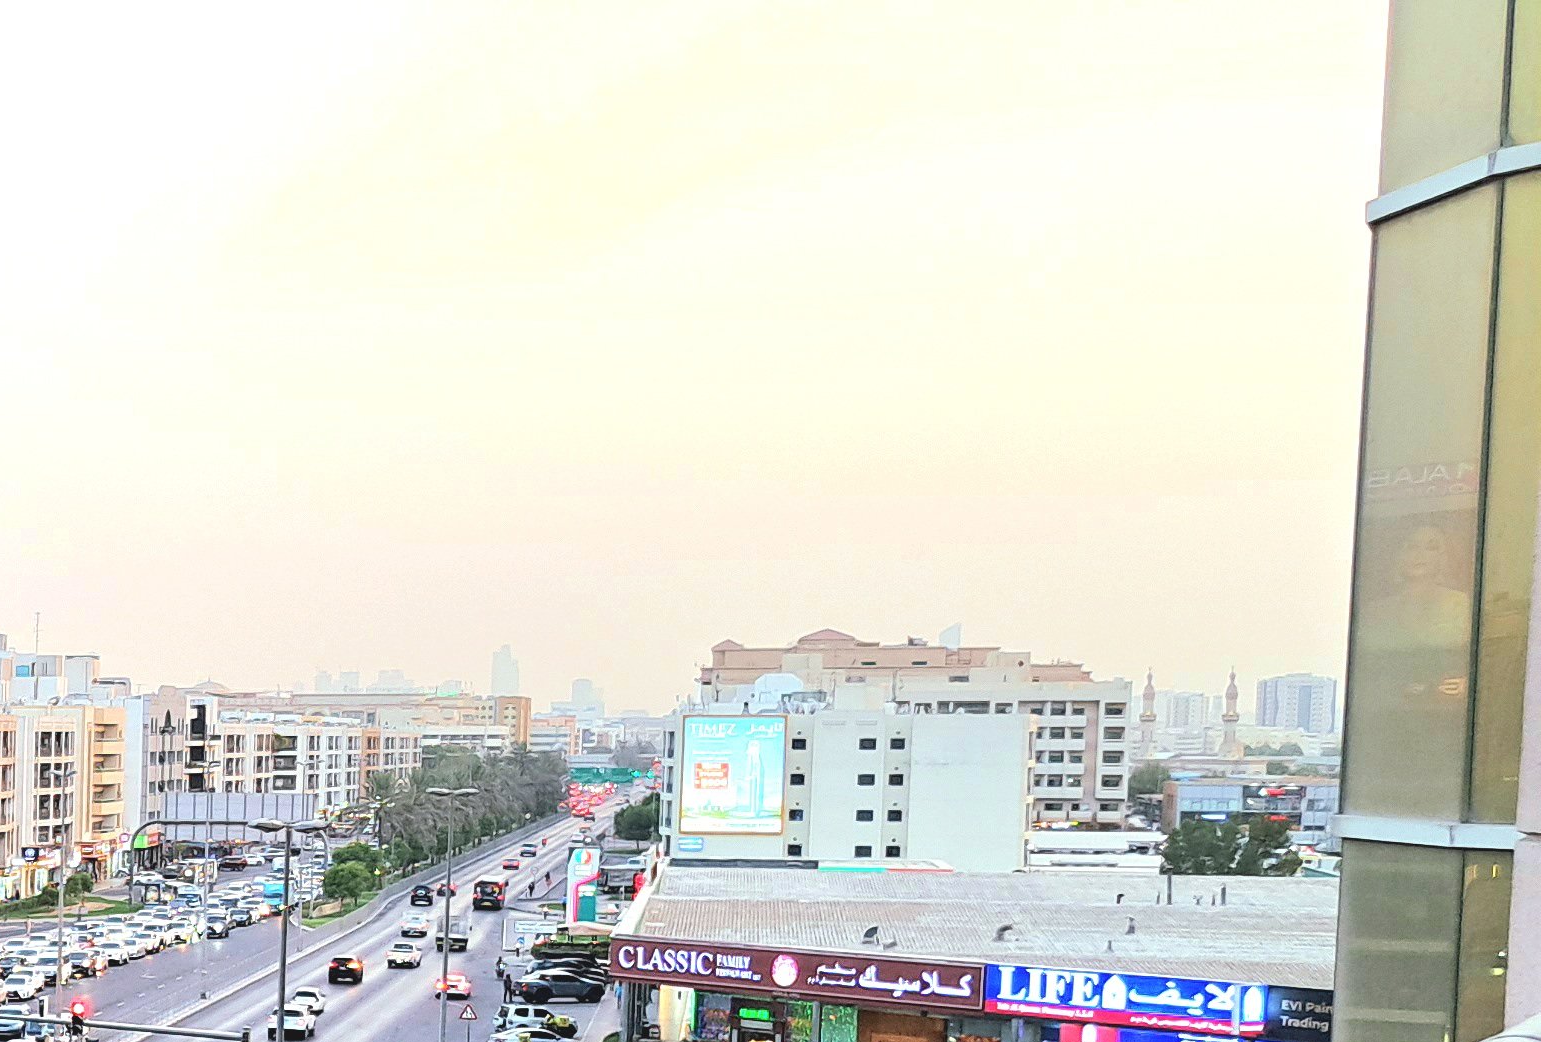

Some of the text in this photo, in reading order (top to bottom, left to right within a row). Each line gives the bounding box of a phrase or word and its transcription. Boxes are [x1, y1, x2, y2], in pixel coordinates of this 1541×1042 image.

[618, 946, 714, 975] CLASSIC
[716, 953, 751, 969] FAMILY
[859, 965, 973, 997] كلاسيك
[997, 966, 1099, 1007] LIFE
[1128, 981, 1237, 1015] لايف
[1281, 1000, 1302, 1011] EVI
[1280, 1016, 1329, 1032] Trading
